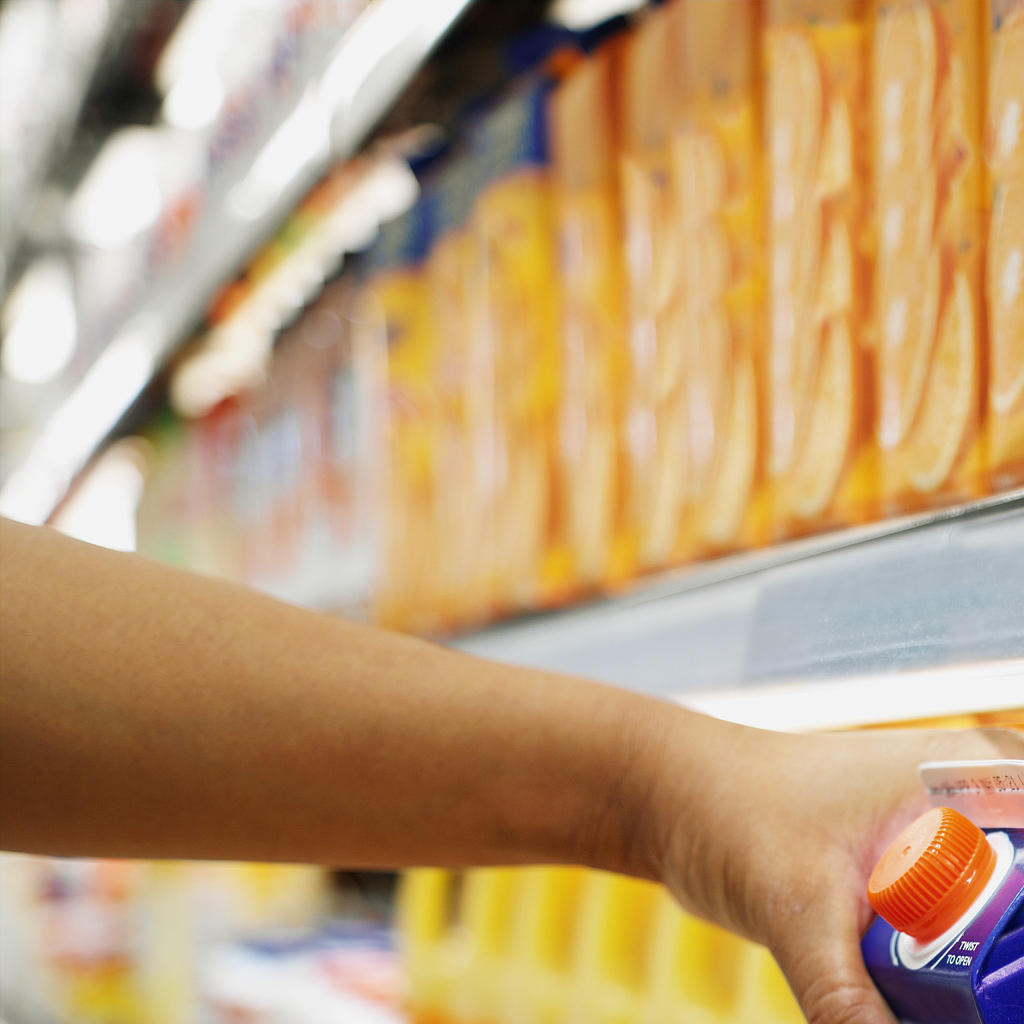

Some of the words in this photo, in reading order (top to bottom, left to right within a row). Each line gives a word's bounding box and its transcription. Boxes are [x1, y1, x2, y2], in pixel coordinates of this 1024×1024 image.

[959, 940, 980, 952] TWIST
[946, 954, 956, 965] TO
[955, 955, 973, 967] OPEN
